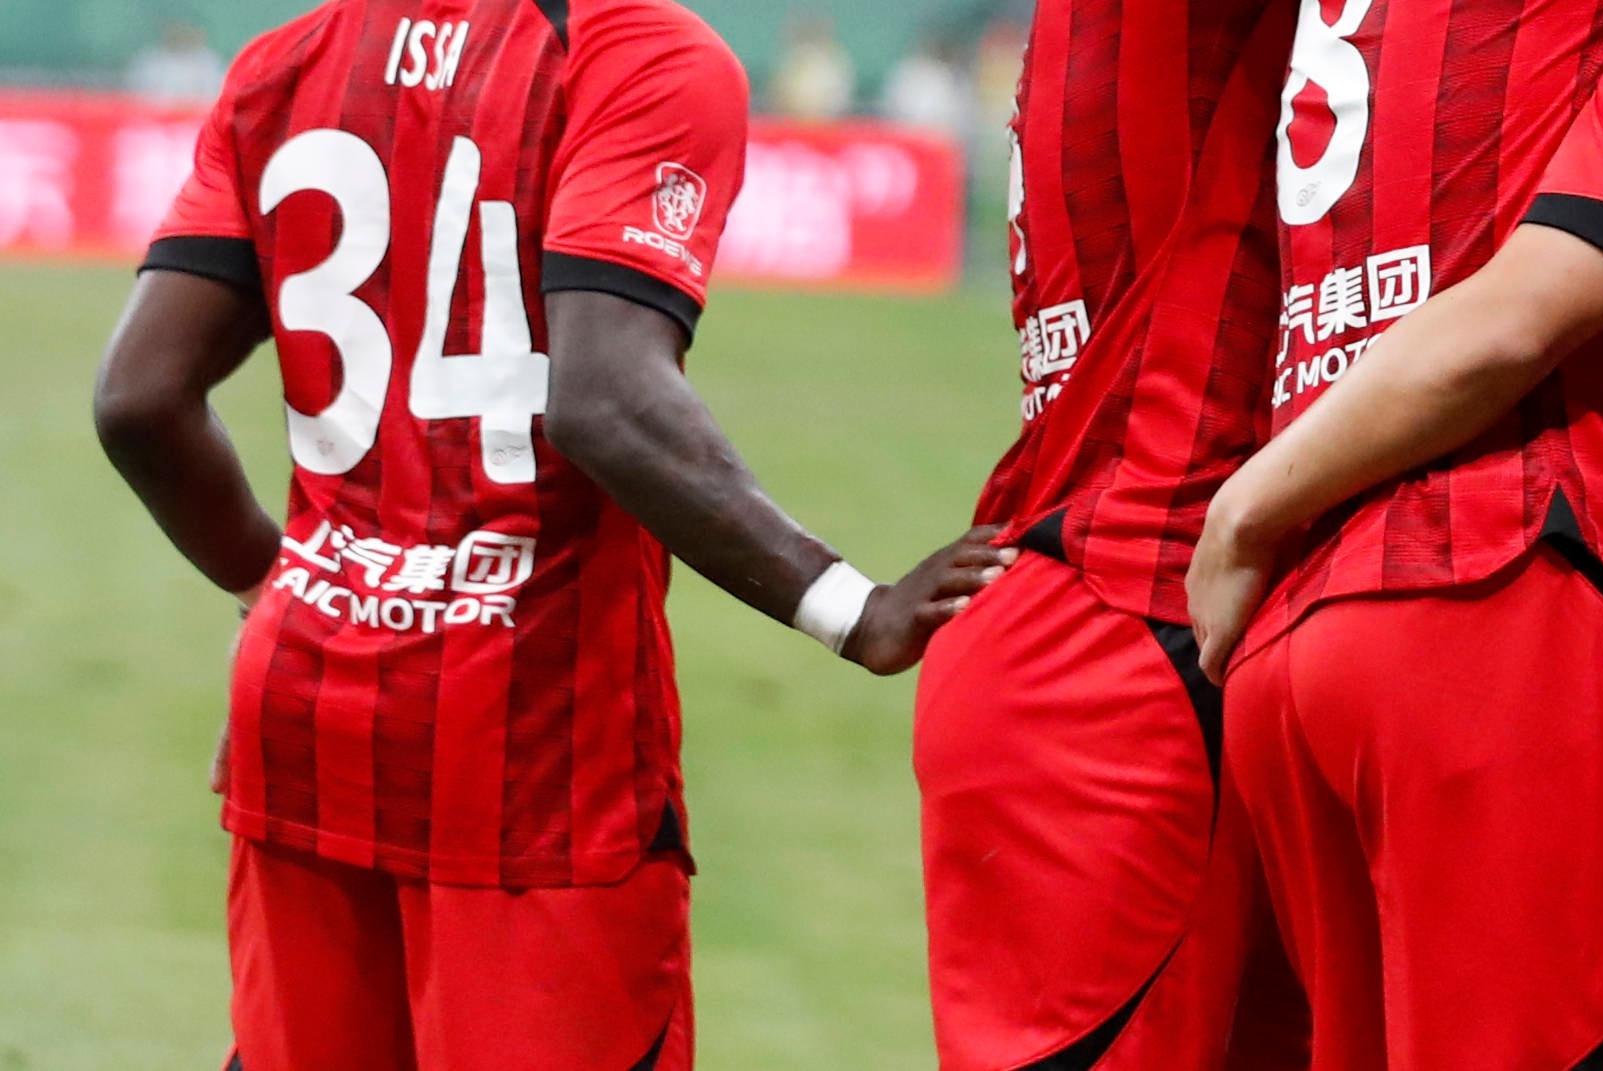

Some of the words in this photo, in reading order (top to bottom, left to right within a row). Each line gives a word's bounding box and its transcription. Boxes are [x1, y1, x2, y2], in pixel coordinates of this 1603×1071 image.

[385, 17, 469, 90] ISSA
[260, 129, 549, 484] 34
[281, 519, 536, 594] 上汽集团
[273, 557, 351, 617] AIC
[351, 594, 516, 633] MOTOR
